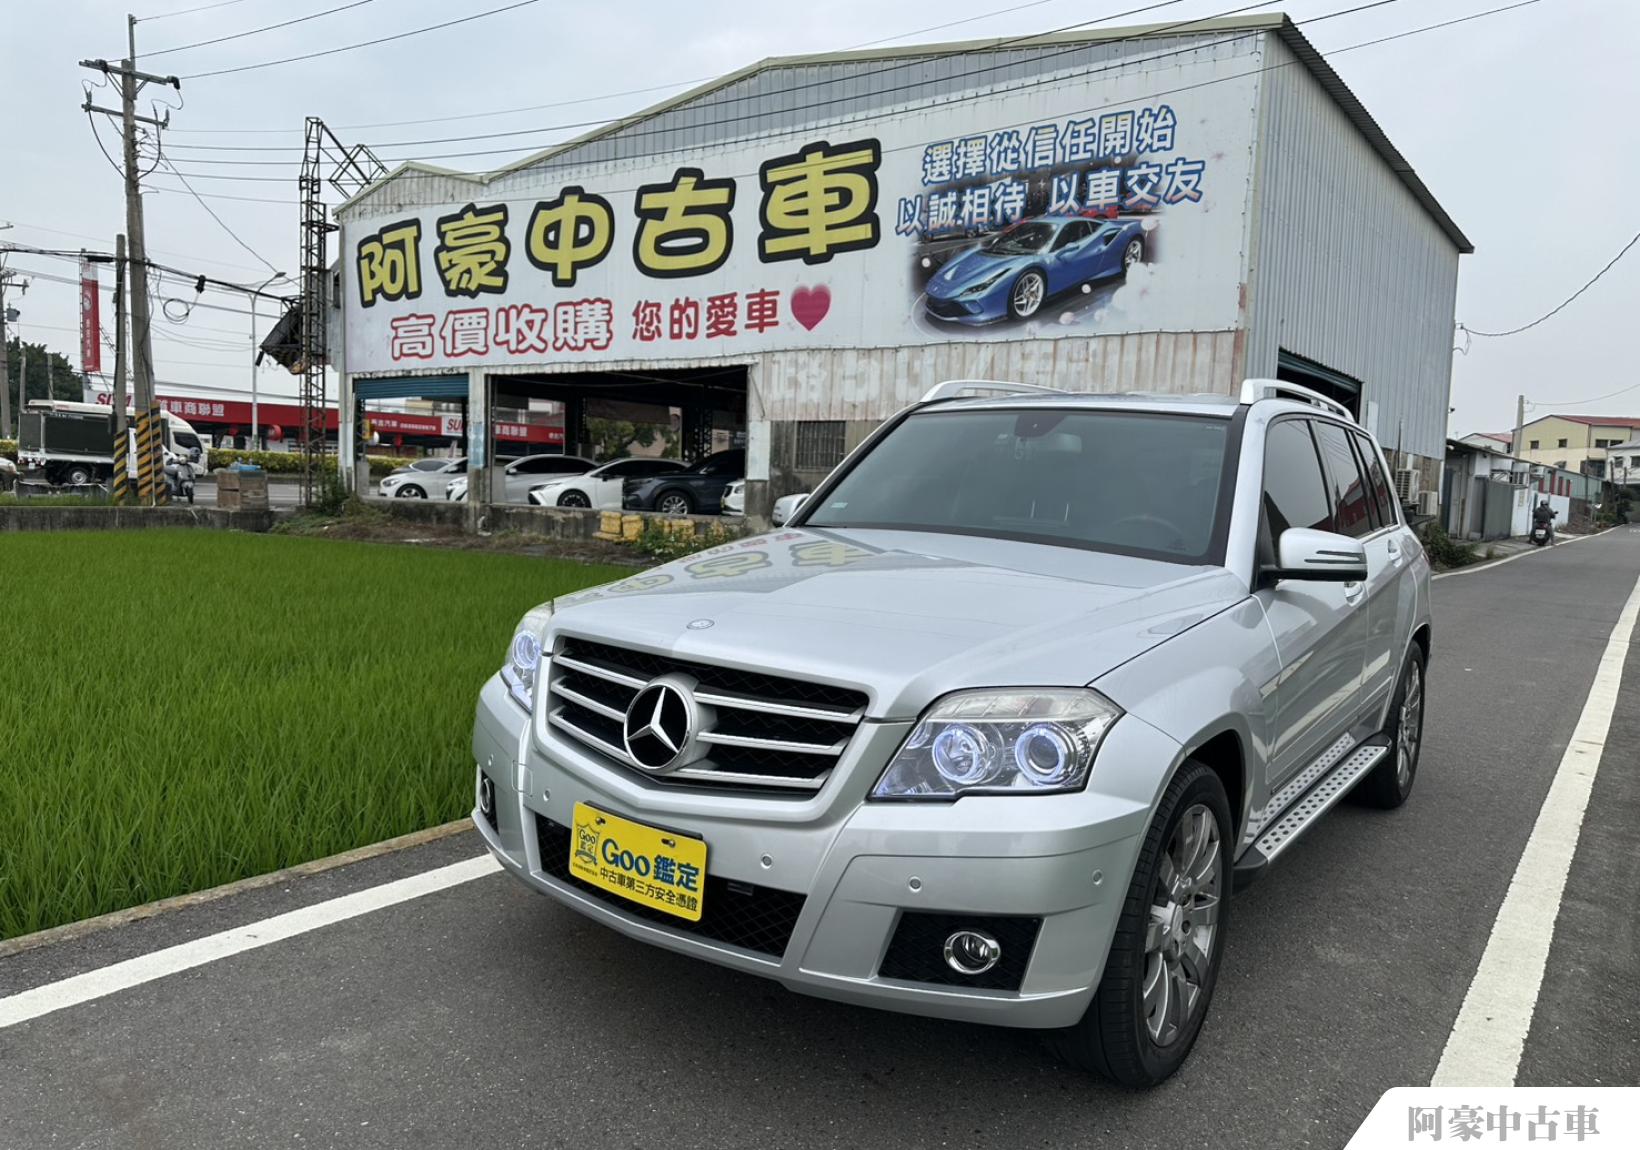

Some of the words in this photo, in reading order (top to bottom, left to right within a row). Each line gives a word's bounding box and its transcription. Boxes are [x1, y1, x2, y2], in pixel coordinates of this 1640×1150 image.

[922, 105, 1177, 186] 選擇從信任開始
[357, 138, 881, 307] 阿豪中古車
[896, 181, 1027, 236] 以誠相待
[1049, 158, 1205, 214] 以車交友
[391, 297, 613, 360] 高價收購
[632, 288, 780, 342] 您的愛車
[580, 829, 596, 844] Goo
[601, 838, 651, 877] Goo
[653, 854, 699, 892] 鑑定
[600, 867, 698, 912] 中古車第三方安全憑證
